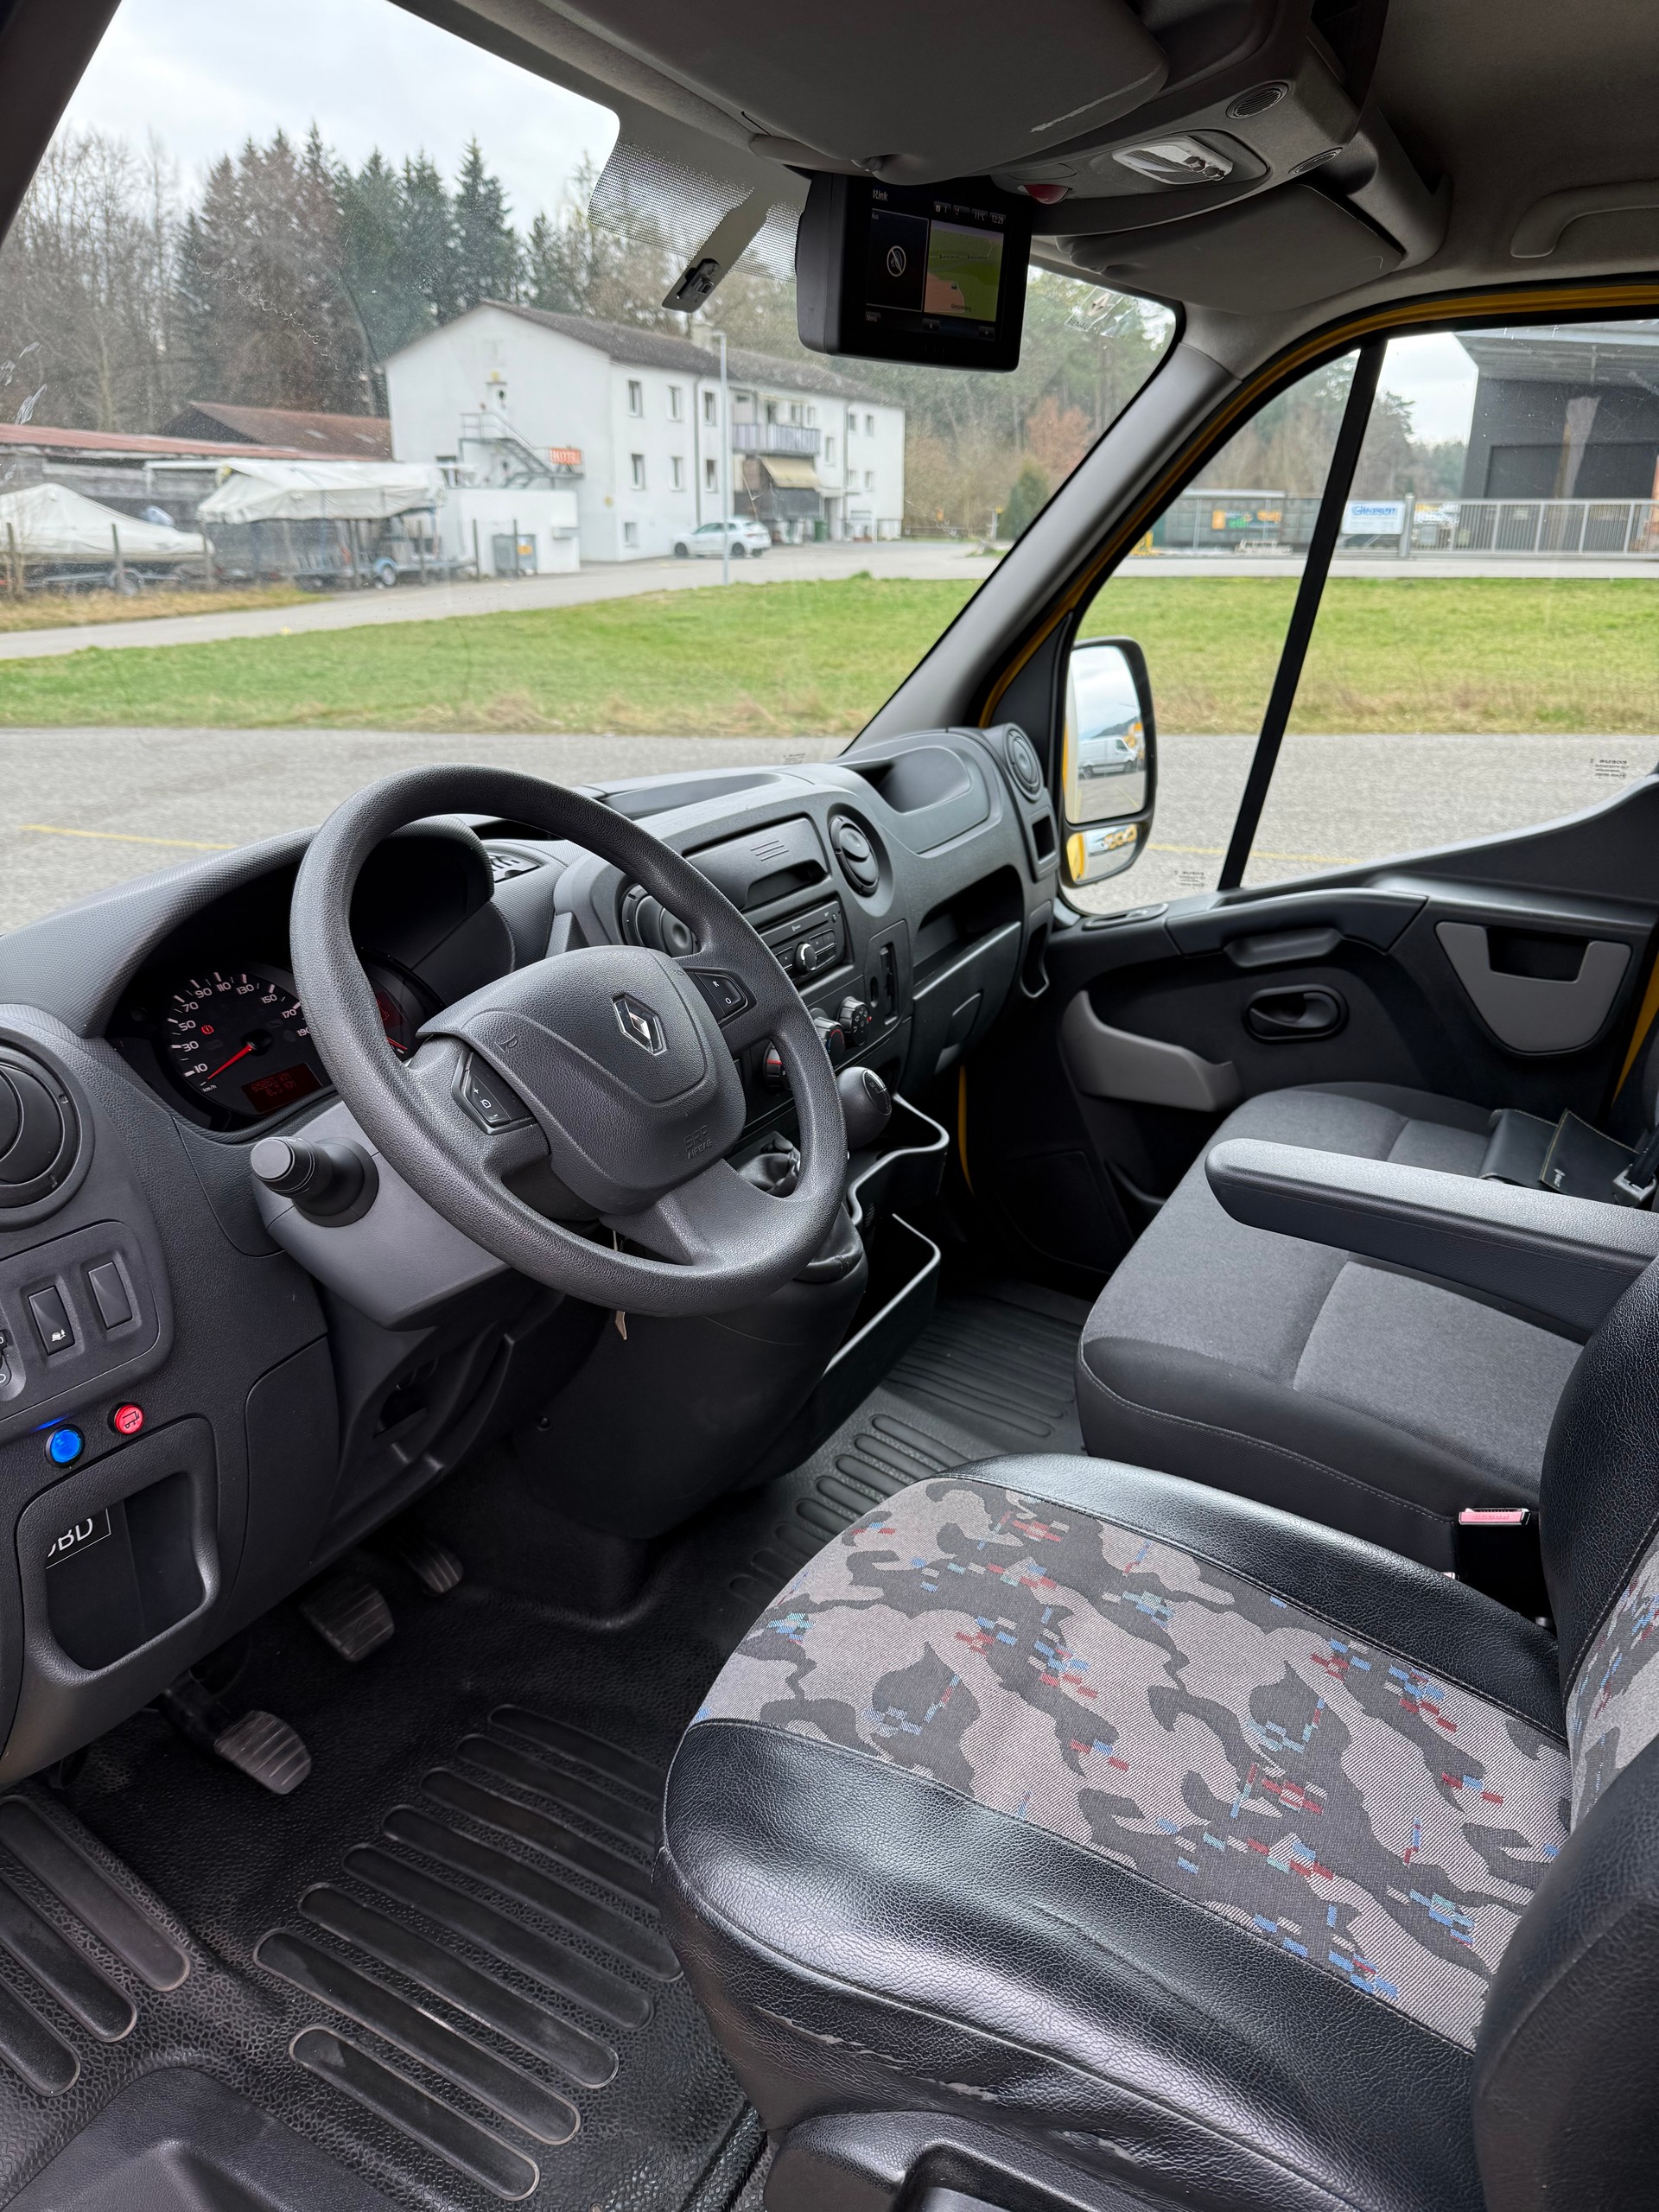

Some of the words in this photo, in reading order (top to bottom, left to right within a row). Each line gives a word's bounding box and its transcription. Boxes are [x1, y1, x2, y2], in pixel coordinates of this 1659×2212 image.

[194, 987, 213, 999] 90
[215, 982, 232, 993] 110
[237, 983, 255, 995] 130
[262, 994, 277, 1004] 150
[181, 1001, 199, 1013] 70
[282, 1008, 297, 1019] 170
[178, 1020, 196, 1032] 50
[181, 1040, 200, 1052] 30
[194, 1063, 208, 1074] 10
[202, 1084, 218, 1093] km/h
